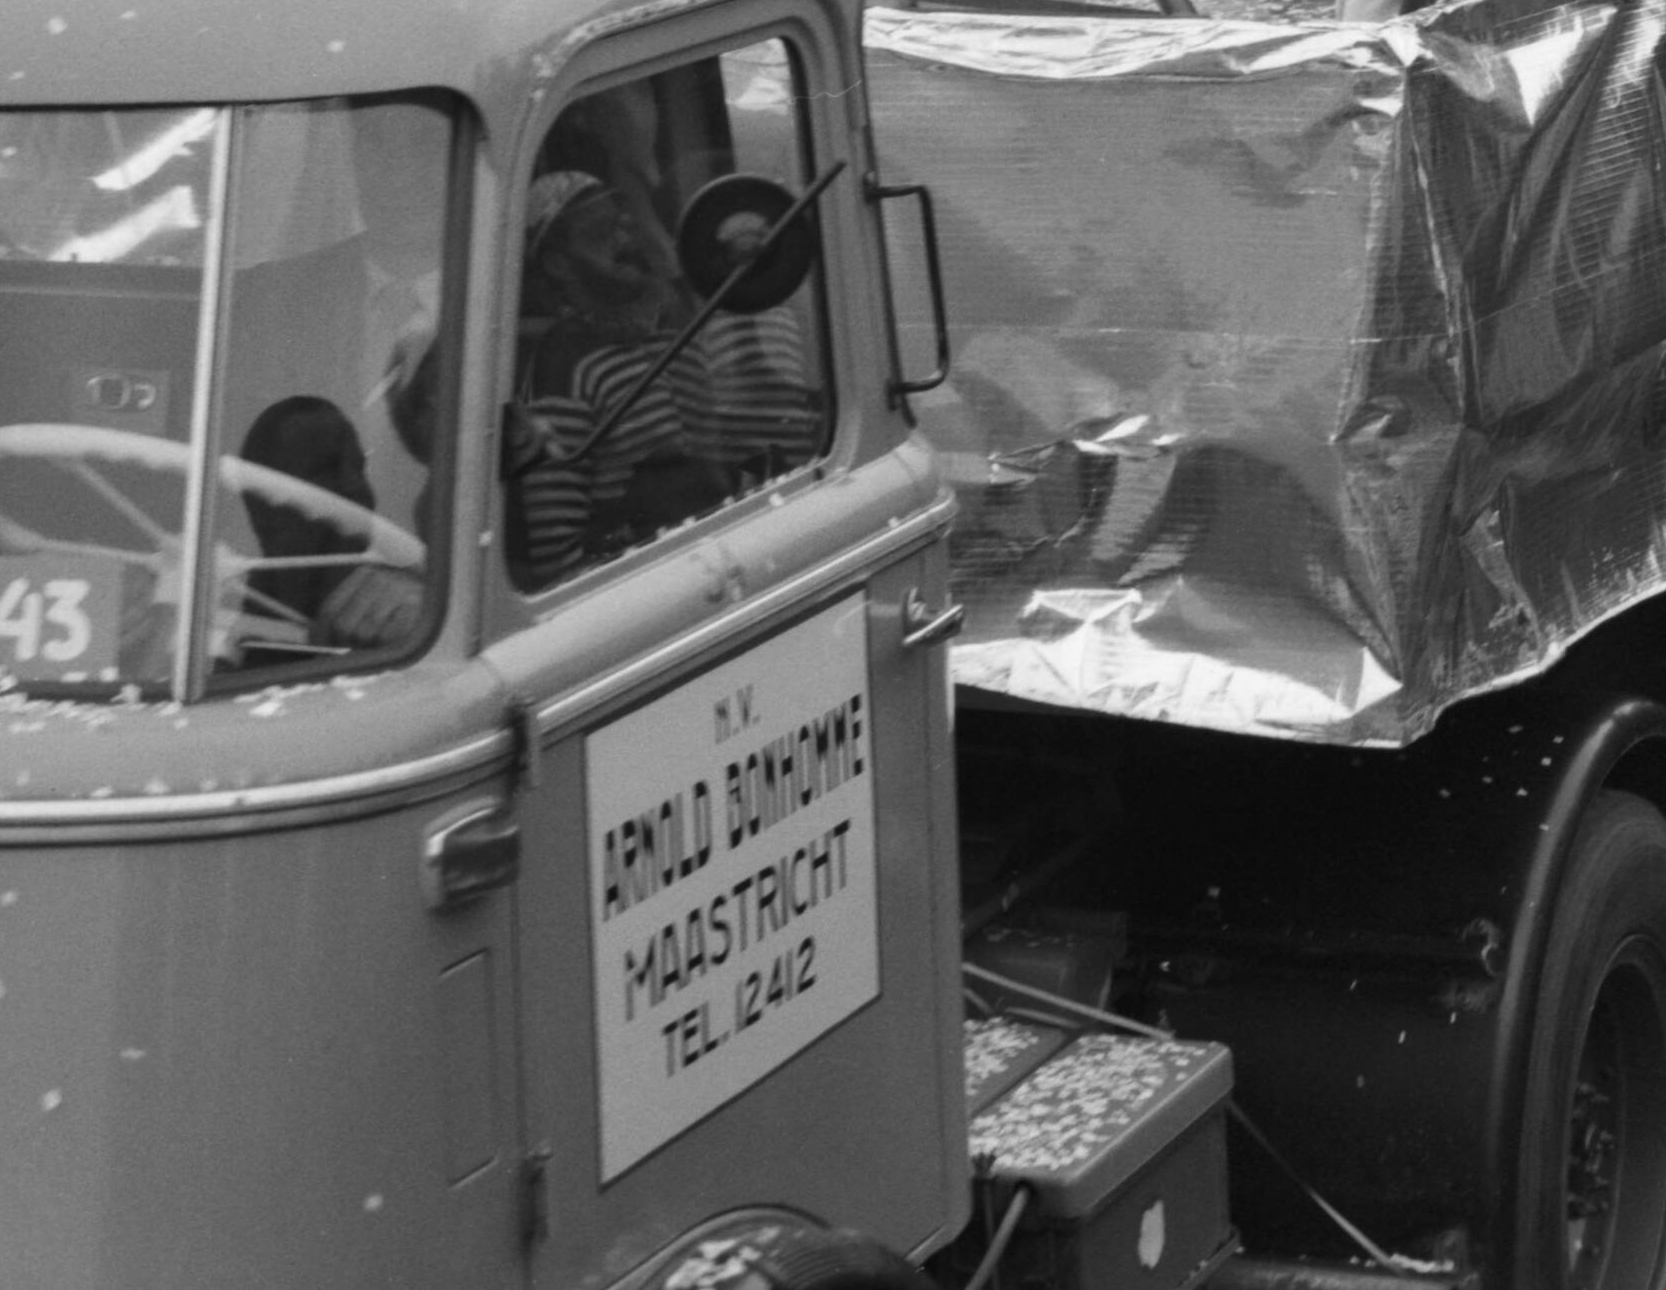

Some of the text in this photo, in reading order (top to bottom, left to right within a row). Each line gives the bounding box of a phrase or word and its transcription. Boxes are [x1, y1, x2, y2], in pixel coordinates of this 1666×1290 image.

[603, 692, 864, 922] ARNOLD BONHOMME
[624, 818, 851, 1022] MAASTRICHT
[661, 935, 817, 1078] TEL. 12412
